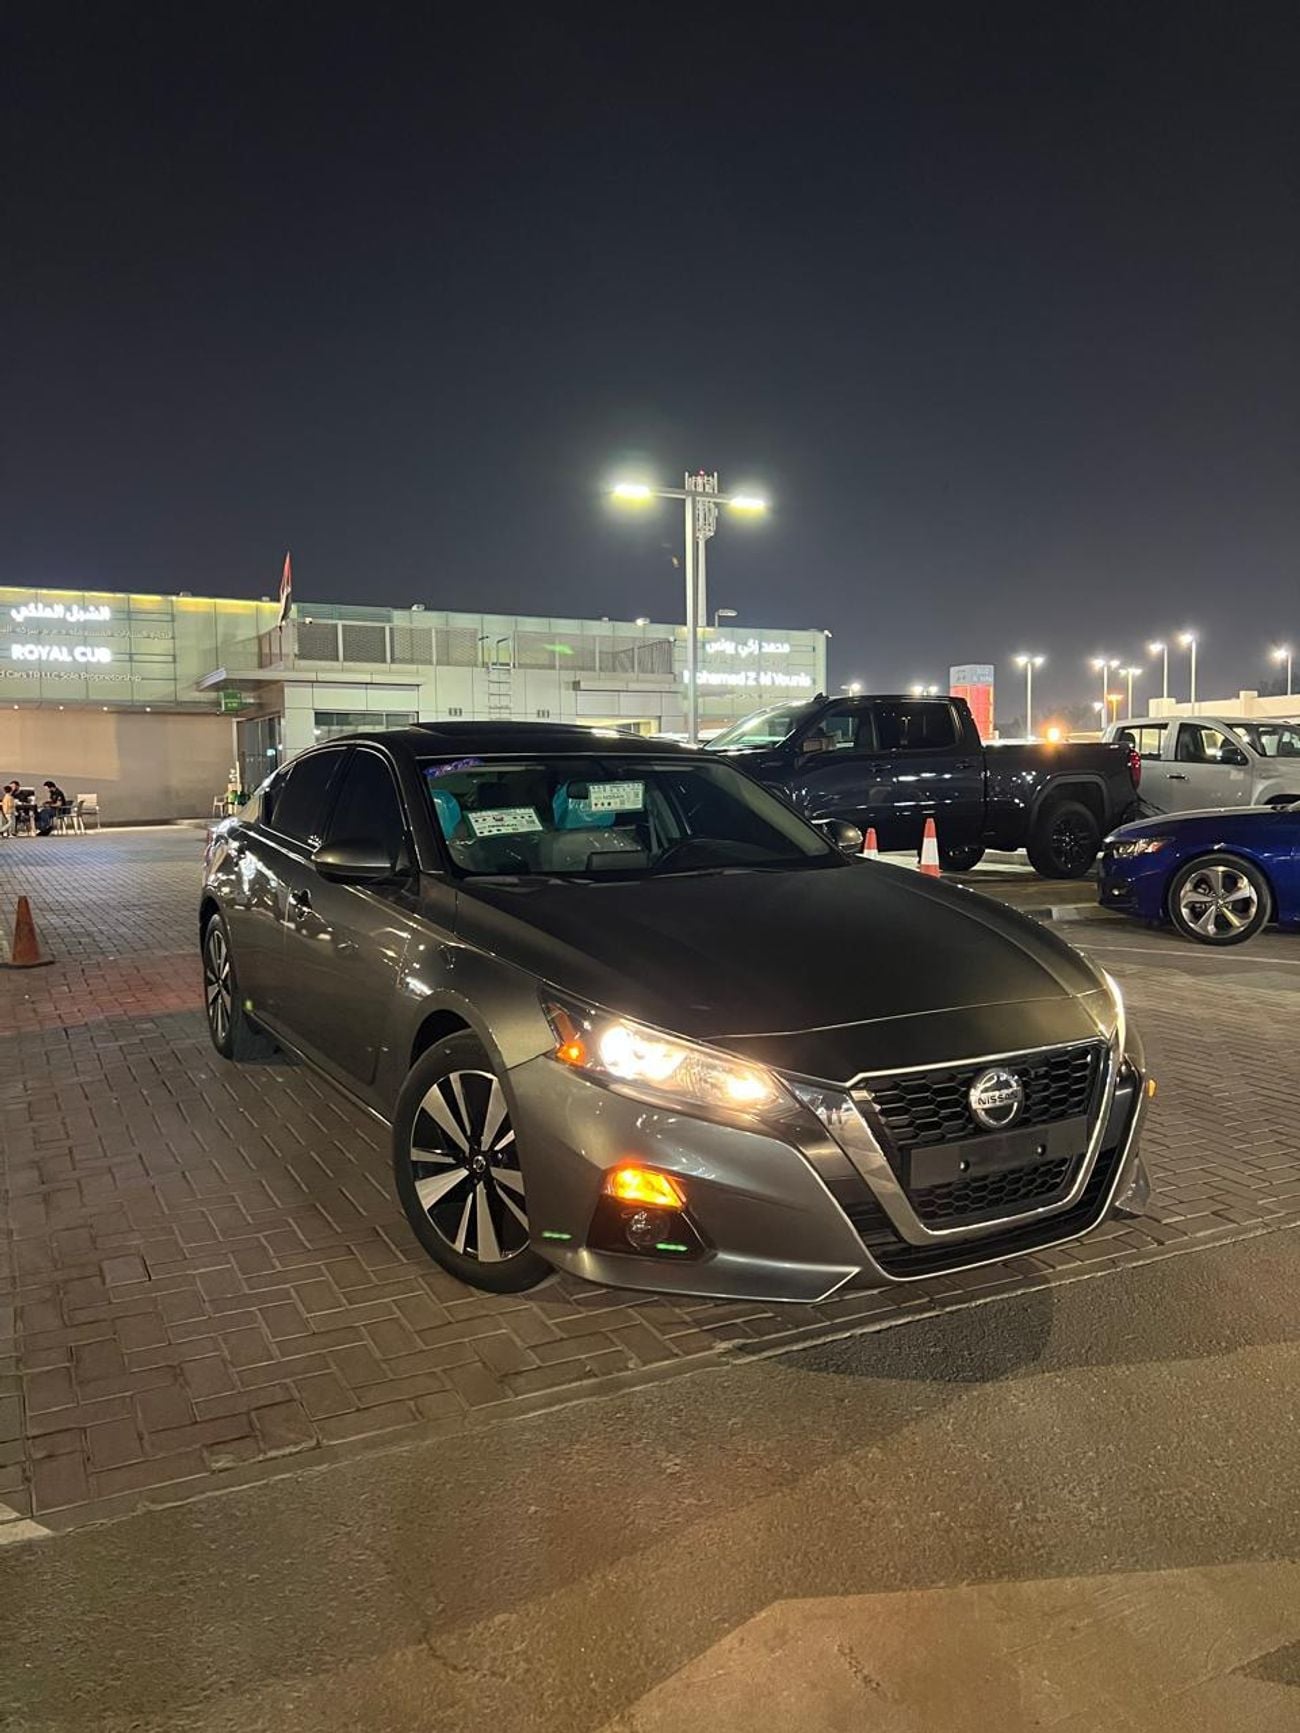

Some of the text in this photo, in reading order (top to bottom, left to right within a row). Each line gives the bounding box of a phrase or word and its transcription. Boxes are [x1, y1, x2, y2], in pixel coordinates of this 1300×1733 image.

[11, 644, 112, 663] ROYAL CUB
[61, 672, 80, 681] Sole
[80, 672, 142, 683] Proprietorship
[977, 1090, 1018, 1106] NISSAN
